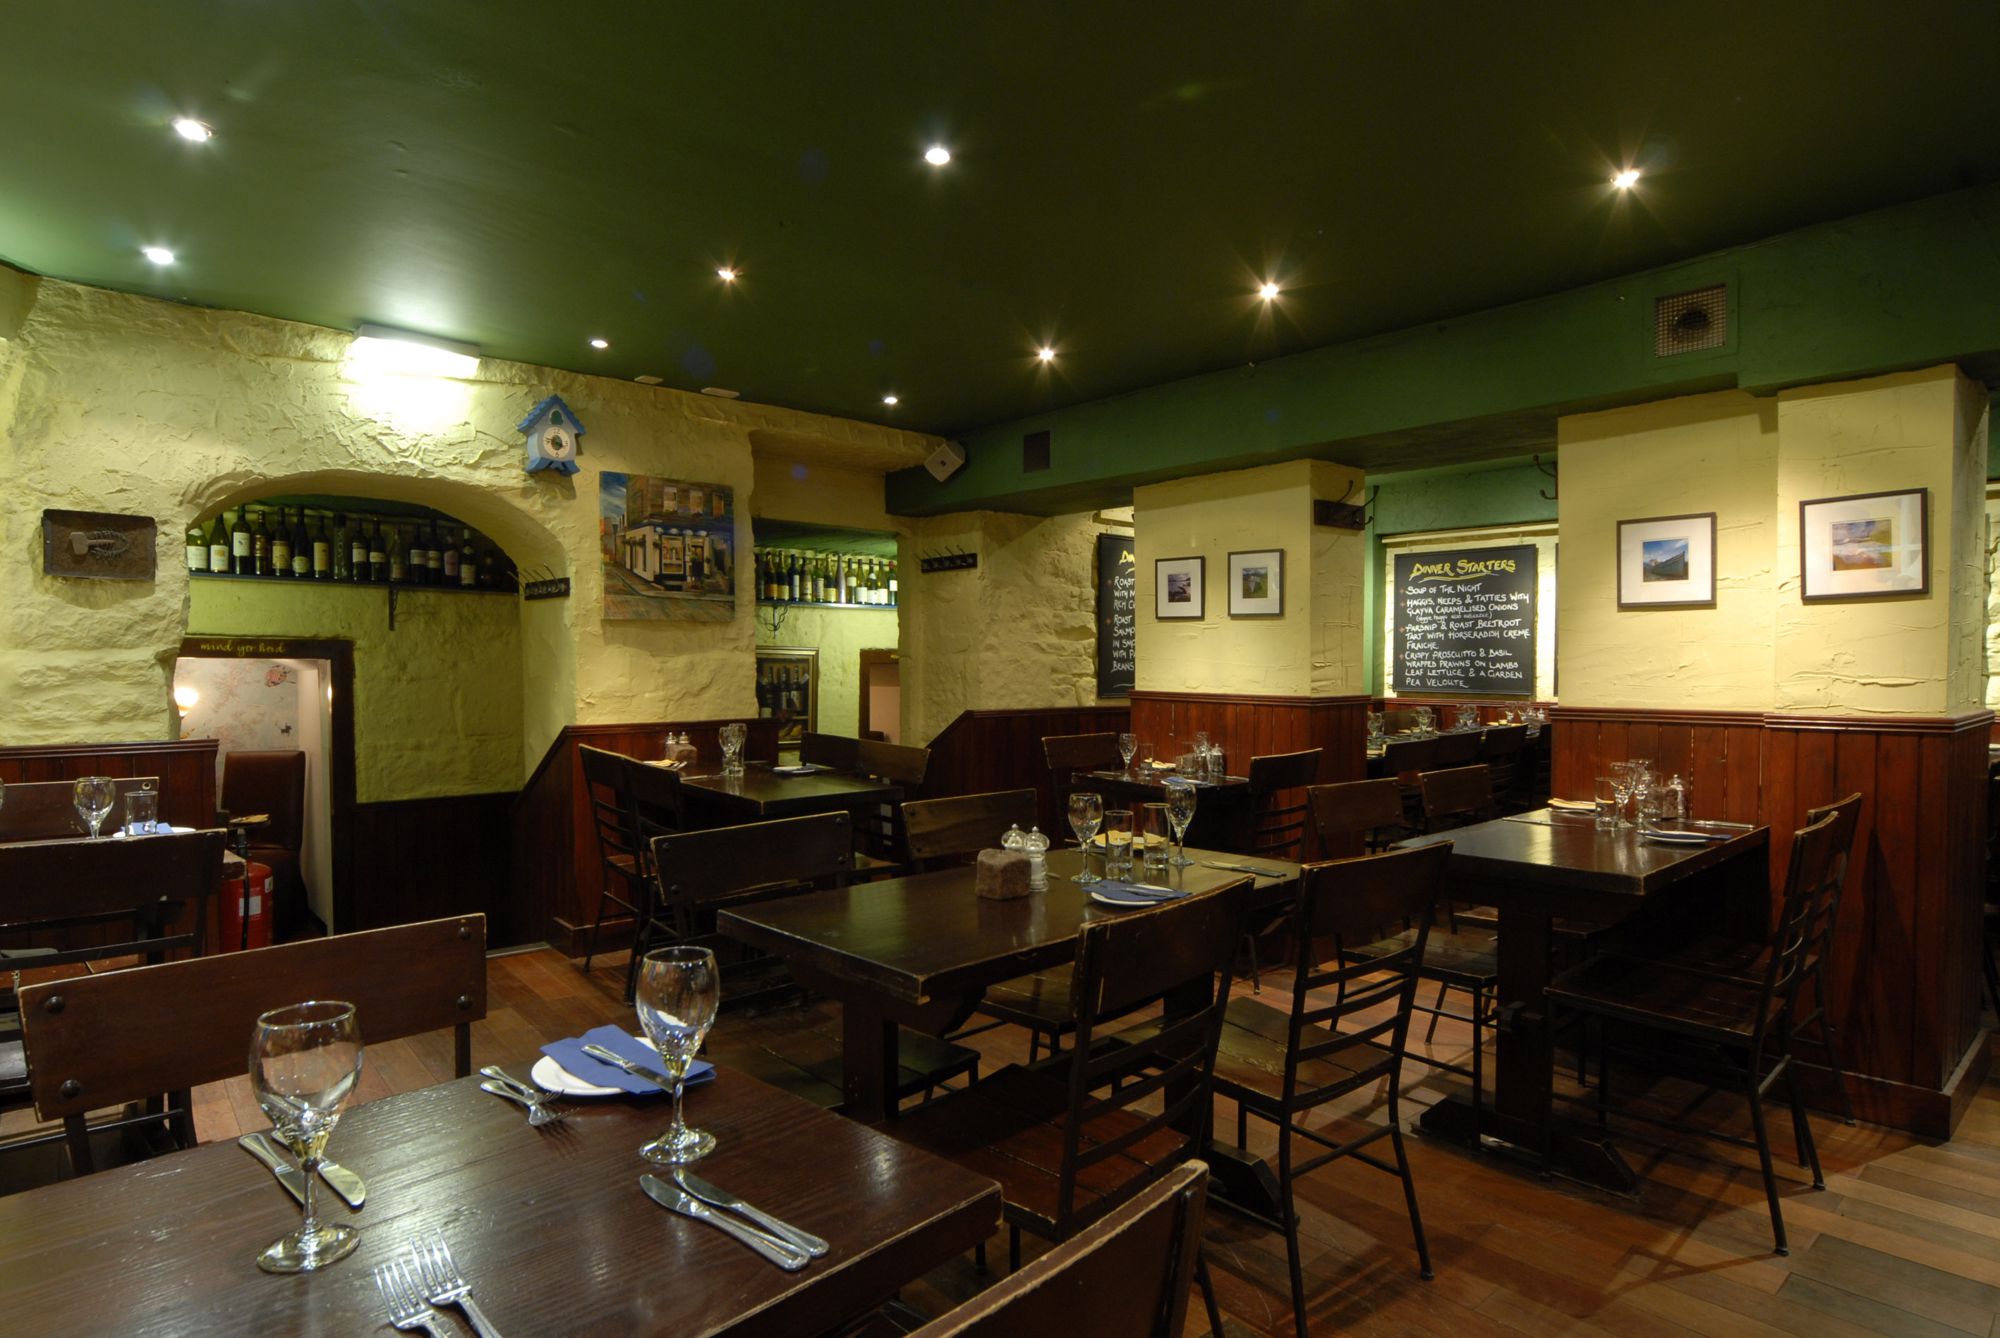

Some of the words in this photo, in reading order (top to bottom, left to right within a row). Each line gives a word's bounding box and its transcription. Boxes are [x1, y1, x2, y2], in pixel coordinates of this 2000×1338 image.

[1409, 562, 1454, 580] DINNER
[1456, 560, 1516, 574] STARTERS
[1114, 576, 1135, 589] ROAST
[1406, 587, 1425, 595] SOUP
[1440, 584, 1456, 594] THE
[1458, 583, 1482, 592] NIGHT
[1438, 597, 1462, 605] NEEPS
[1465, 594, 1472, 603] &
[1474, 594, 1506, 602] TATTIES
[1510, 592, 1529, 603] WITH
[1436, 605, 1486, 615] CARAMELISED
[1488, 603, 1518, 611] ONIONS
[1114, 614, 1132, 626] ROAST
[1406, 624, 1437, 632] PARSNIP
[1440, 621, 1447, 630] &
[1450, 621, 1474, 630] ROAST
[1476, 619, 1522, 629] BEETROOT
[1406, 632, 1424, 640] TART
[1427, 632, 1444, 640] WITH
[1448, 630, 1500, 639] HORSERADISH
[1503, 629, 1530, 639] CREME
[200, 640, 233, 652] mind
[1406, 641, 1439, 650] FRAICHE
[1405, 652, 1428, 660] CRISPY
[1480, 648, 1486, 657] &
[1488, 649, 1512, 658] BASIL
[1111, 660, 1134, 672] BEANS
[1405, 668, 1424, 676] LEAF
[1469, 668, 1475, 677] &
[1488, 670, 1523, 679] GARDEN
[1406, 678, 1421, 686] PEA
